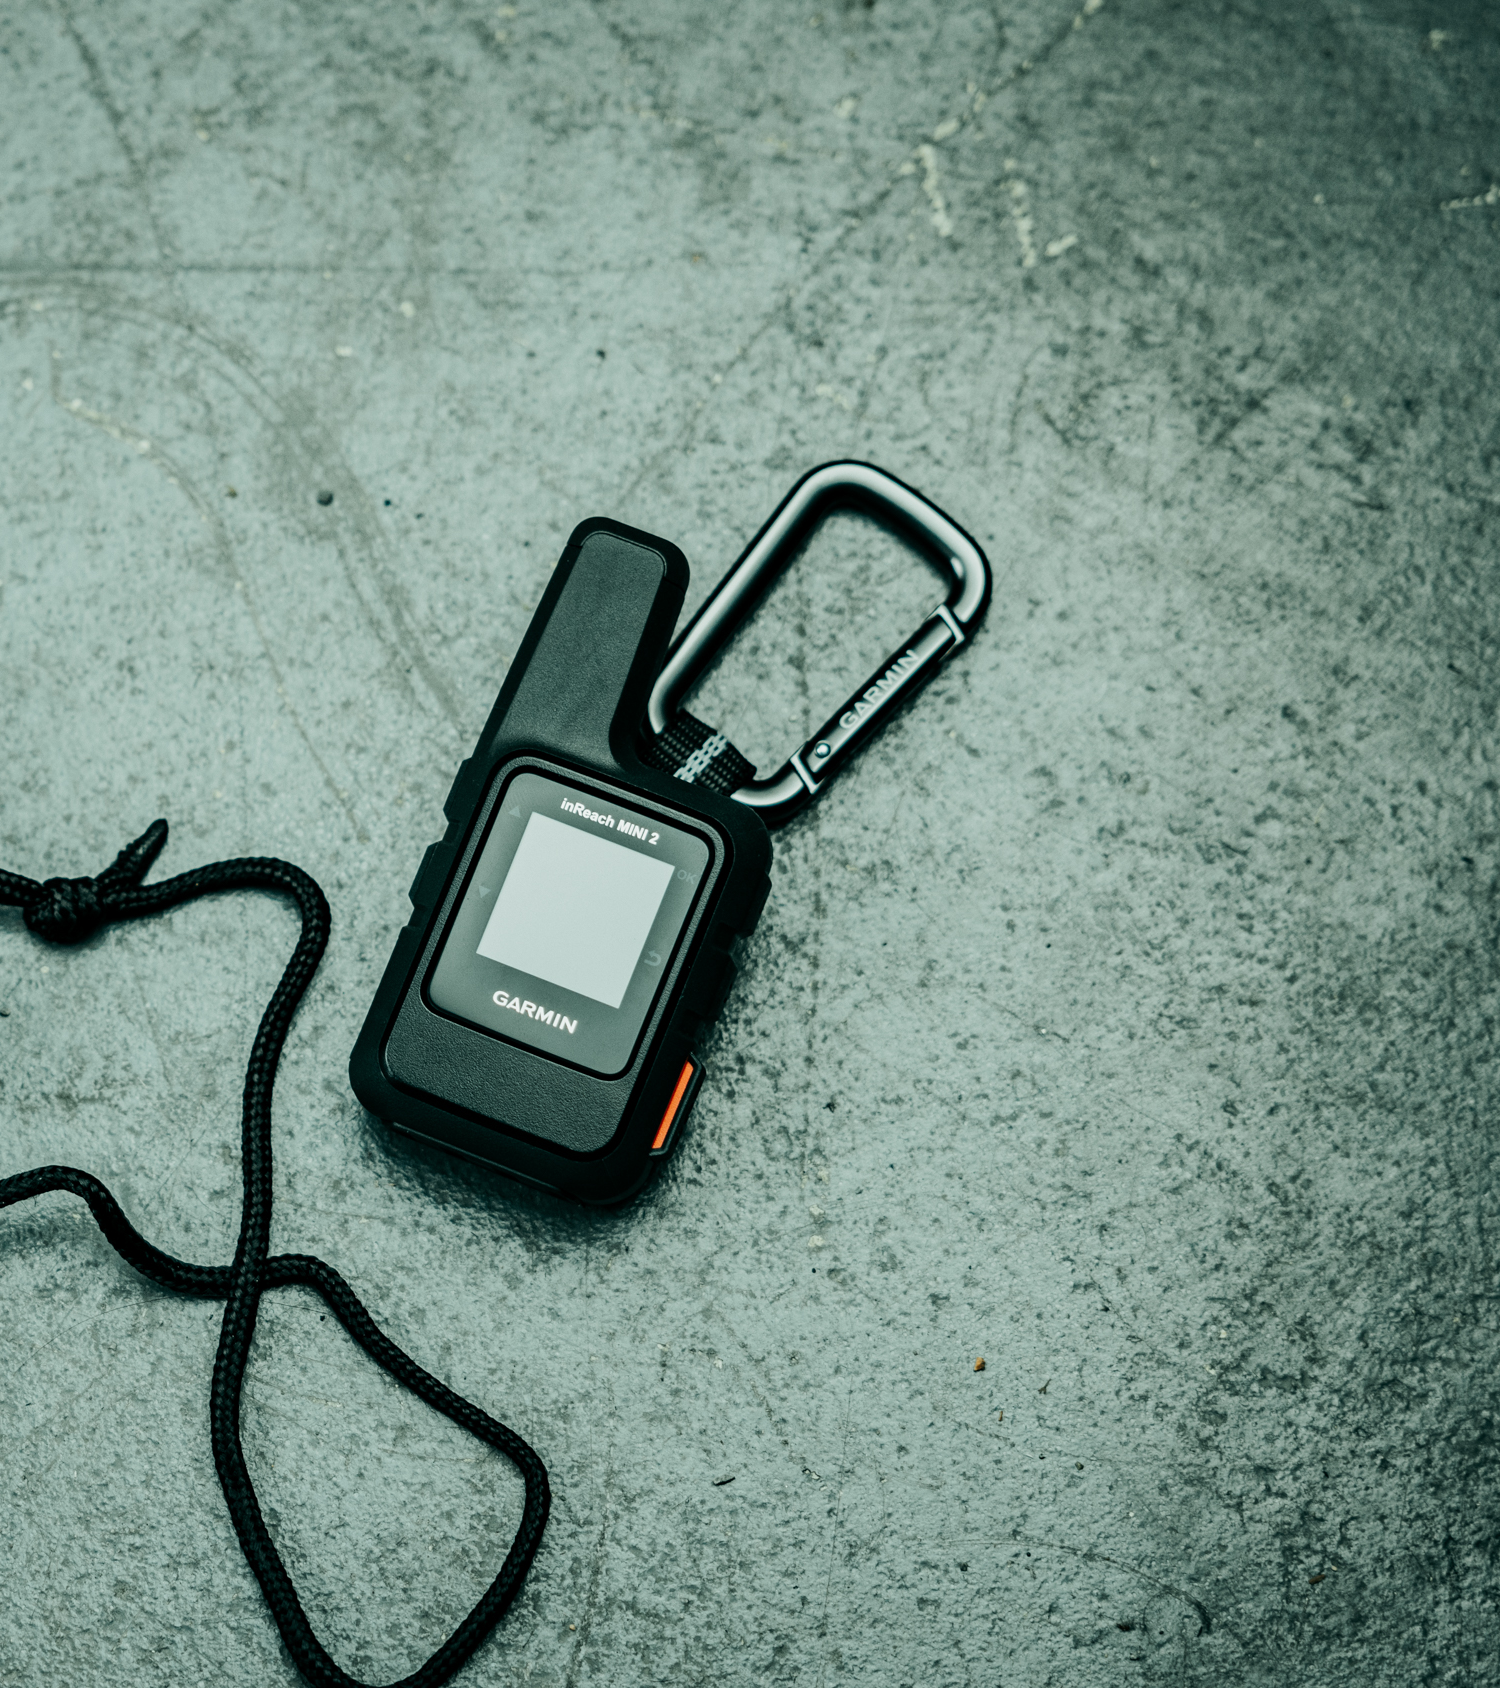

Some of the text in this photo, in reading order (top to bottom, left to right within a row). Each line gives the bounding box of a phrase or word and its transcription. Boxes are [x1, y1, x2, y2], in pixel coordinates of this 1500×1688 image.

[838, 649, 920, 730] GARMIN
[560, 797, 661, 846] inReach MINI 2
[676, 869, 698, 885] OK
[492, 990, 579, 1035] GARMIN
